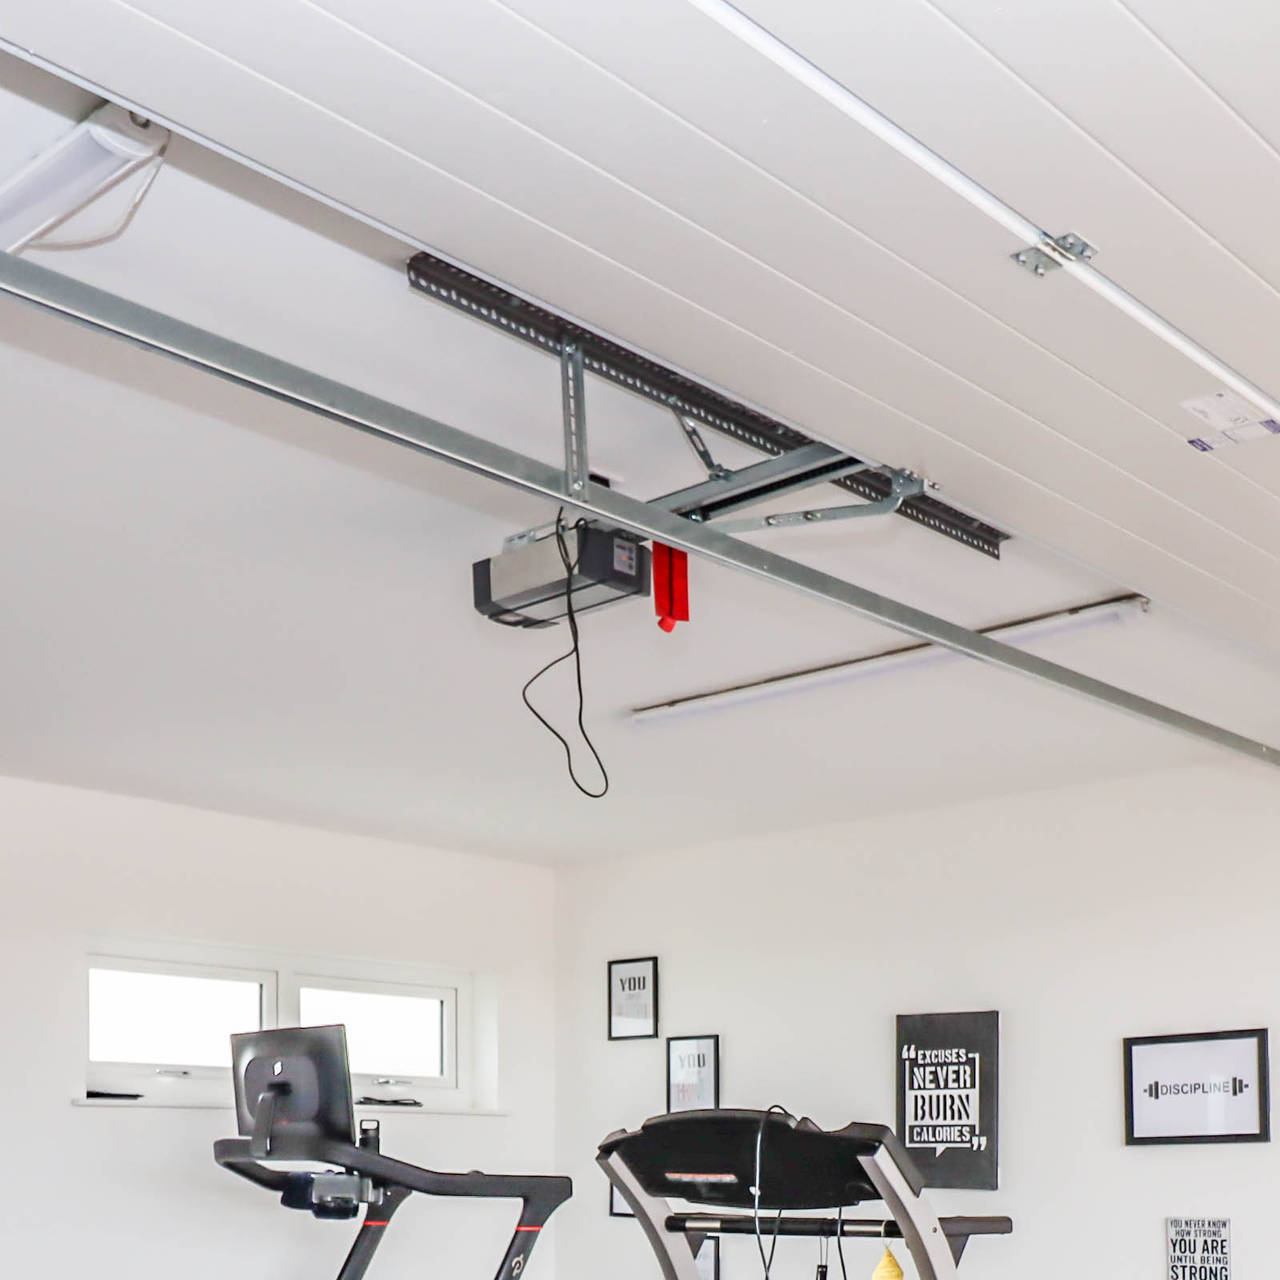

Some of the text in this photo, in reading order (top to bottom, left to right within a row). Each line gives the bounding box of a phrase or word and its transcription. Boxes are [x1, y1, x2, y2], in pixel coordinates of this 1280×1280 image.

[619, 976, 646, 992] YOU
[913, 1065, 971, 1089] NEVER
[1160, 1080, 1230, 1096] DISCIPLINE
[914, 1094, 970, 1121] BURN
[1170, 1219, 1227, 1228] YOU NEVER KNOW
[1175, 1229, 1222, 1238] HOW STRONG
[1170, 1238, 1228, 1255] YOU ARE
[1170, 1255, 1228, 1265] UNTIL BEING
